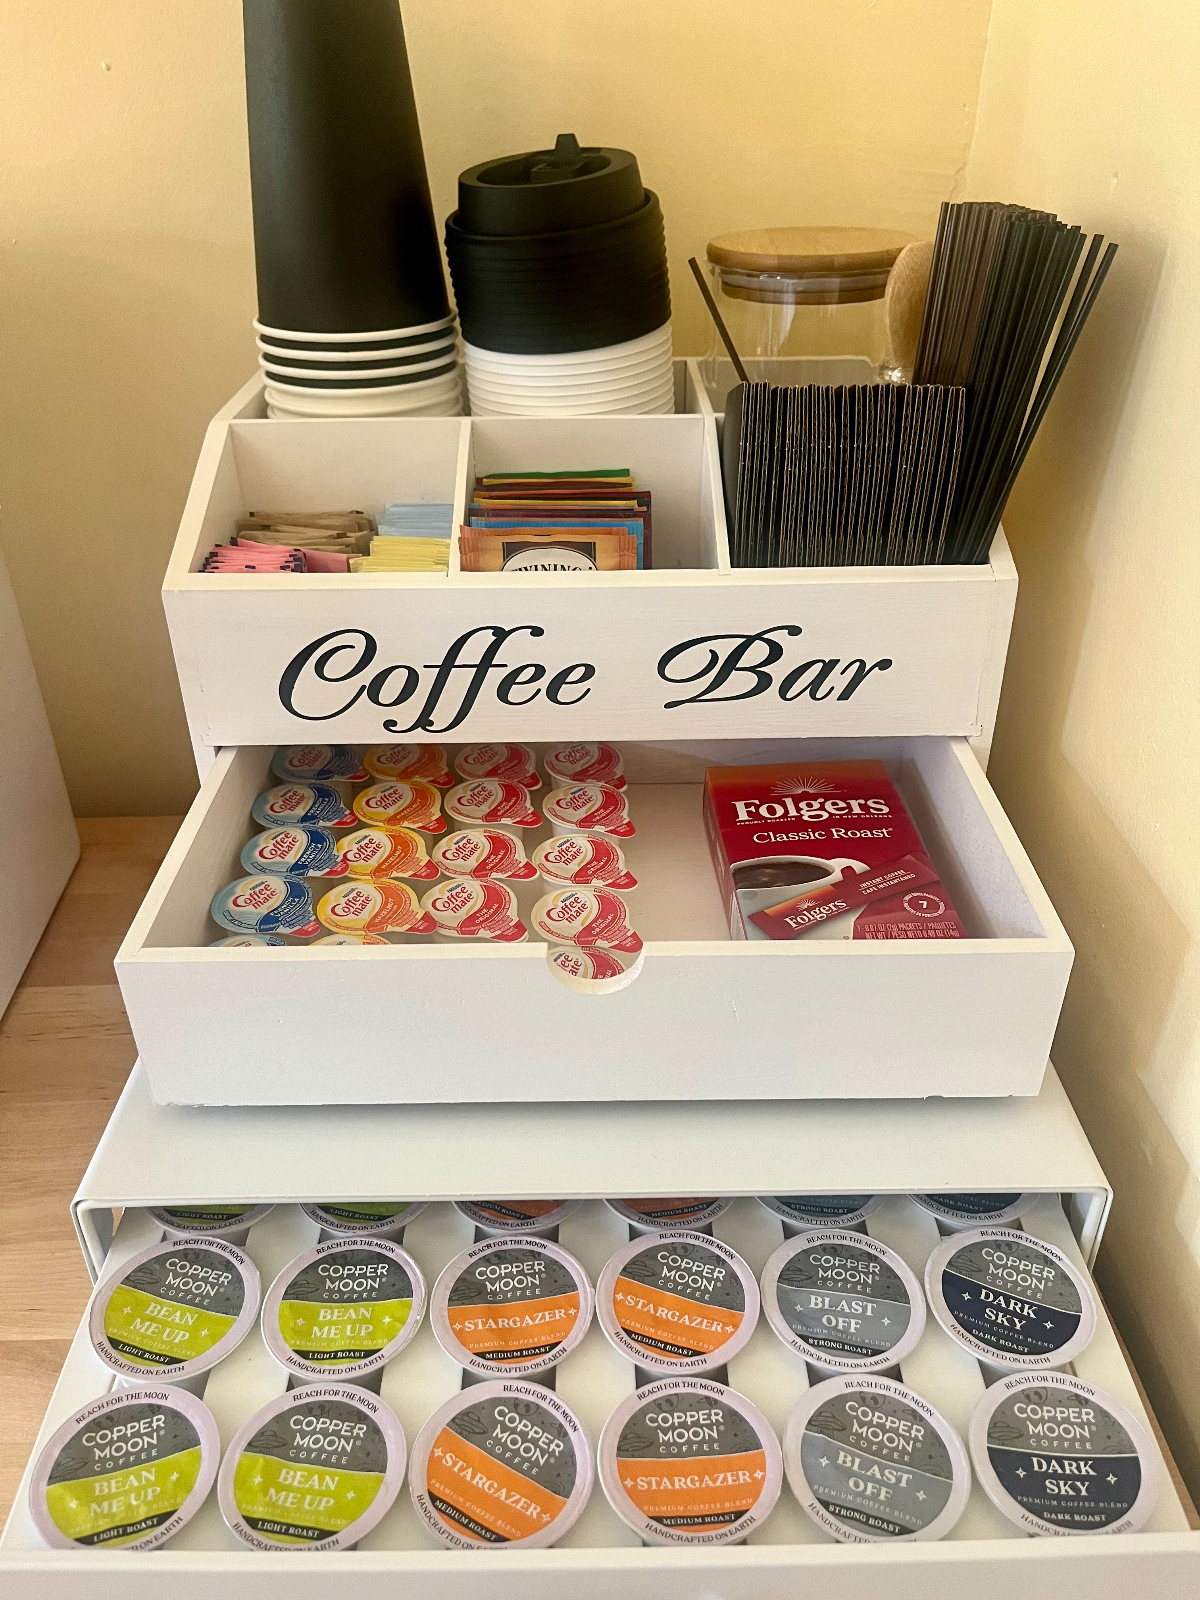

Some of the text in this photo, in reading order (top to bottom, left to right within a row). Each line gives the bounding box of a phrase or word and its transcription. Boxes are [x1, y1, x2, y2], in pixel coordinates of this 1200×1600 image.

[278, 625, 892, 733] Coffee Bar
[269, 790, 300, 813] Coffee
[288, 794, 306, 812] mate
[365, 788, 399, 809] Coffee
[382, 793, 403, 810] mate
[457, 785, 488, 807] Coffee
[474, 791, 495, 808] mate
[556, 790, 589, 810] Coffee
[572, 796, 593, 812] mate
[731, 797, 890, 821] Folgers
[259, 832, 292, 860] Coffee
[753, 828, 891, 843] Classic Roast
[278, 836, 298, 860] mate
[343, 837, 376, 862] Coffee
[362, 844, 382, 863] mate
[442, 838, 474, 861] Coffee
[460, 844, 479, 862] mate
[544, 840, 578, 863] Coffee
[562, 848, 582, 866] mate
[232, 883, 271, 908] Coffee
[252, 890, 277, 910] mate
[331, 891, 362, 917] Coffee
[353, 896, 371, 916] mate
[431, 885, 468, 911] Coffee
[451, 892, 474, 913] mate
[918, 900, 927, 909] 7
[475, 903, 499, 924] ORIGINAL
[476, 909, 488, 917] THE
[546, 896, 582, 922] Coffee
[566, 902, 588, 924] mate
[784, 901, 847, 928] Folgers
[592, 918, 603, 927] THE
[592, 913, 614, 934] ORIGINAL
[899, 922, 922, 930] PACKETS
[165, 1258, 232, 1286] COPPER
[318, 1264, 389, 1277] COPPER
[476, 1261, 545, 1279] COPPER
[658, 1252, 726, 1280] COPPER
[810, 1255, 880, 1274] COPPER
[982, 1248, 1055, 1280] COPPER
[165, 1273, 218, 1297] MOON
[325, 1279, 379, 1291] MOON
[486, 1275, 540, 1293] MOON
[662, 1266, 714, 1292] MOON
[818, 1268, 872, 1284] MOON
[818, 1280, 871, 1293] COFFEE
[989, 1263, 1045, 1291] MOON
[160, 1287, 210, 1306] COFFEE
[488, 1289, 541, 1299] COFFEE
[659, 1280, 710, 1300] COFFEE
[986, 1276, 1042, 1299] COFFEE
[145, 1302, 198, 1326] BEAN
[319, 1308, 373, 1321] BEAN
[625, 1295, 723, 1332] STARGAZER
[809, 1295, 876, 1316] BLAST
[979, 1289, 1037, 1319] DARK
[465, 1309, 567, 1331] STARGAZER
[822, 1315, 861, 1333] OFF
[984, 1308, 1027, 1331] SKY
[130, 1318, 190, 1344] ME UP
[312, 1325, 373, 1338] ME UP
[972, 1329, 1029, 1353] DARK ROAST
[119, 1344, 170, 1363] LIGHT ROAST
[486, 1347, 550, 1359] MEDIUM ROAST
[631, 1334, 693, 1355] MEDIUM ROAST
[808, 1339, 872, 1355] STRONG ROAST
[645, 1409, 724, 1427] COPPER
[845, 1401, 924, 1440] COPPER
[1014, 1403, 1095, 1422] COPPER
[82, 1415, 165, 1446] COPPER
[290, 1415, 367, 1437] COPPER
[495, 1406, 564, 1456] COPPER
[658, 1426, 718, 1443] MOON
[852, 1419, 913, 1453] MOON
[1027, 1421, 1091, 1438] MOON
[94, 1432, 158, 1461] MOON
[294, 1433, 353, 1453] MOON
[493, 1424, 548, 1467] MOON
[660, 1443, 720, 1453] COFFEE
[850, 1436, 910, 1461] COFFEE
[1030, 1438, 1092, 1449] COFFEE
[95, 1448, 158, 1471] COFFEE
[290, 1450, 348, 1464] COFFEE
[486, 1440, 539, 1475] COFFEE
[1031, 1457, 1097, 1475] DARK
[836, 1450, 912, 1487] BLAST
[95, 1468, 156, 1496] BEAN
[277, 1468, 339, 1491] BEAN
[442, 1452, 541, 1519] STARGAZER
[637, 1470, 751, 1490] STARGAZER
[848, 1477, 893, 1501] OFF
[1045, 1480, 1090, 1496] SKY
[90, 1487, 161, 1516] ME UP
[265, 1488, 334, 1511] ME UP
[435, 1500, 497, 1541] MEDIUM ROAST
[663, 1514, 736, 1525] MEDIUM ROAST
[828, 1504, 901, 1533] STRONG ROAST
[1044, 1511, 1106, 1522] DARK ROAST
[93, 1518, 159, 1542] LIGHT ROAST
[258, 1521, 319, 1538] LIGHT ROAST
